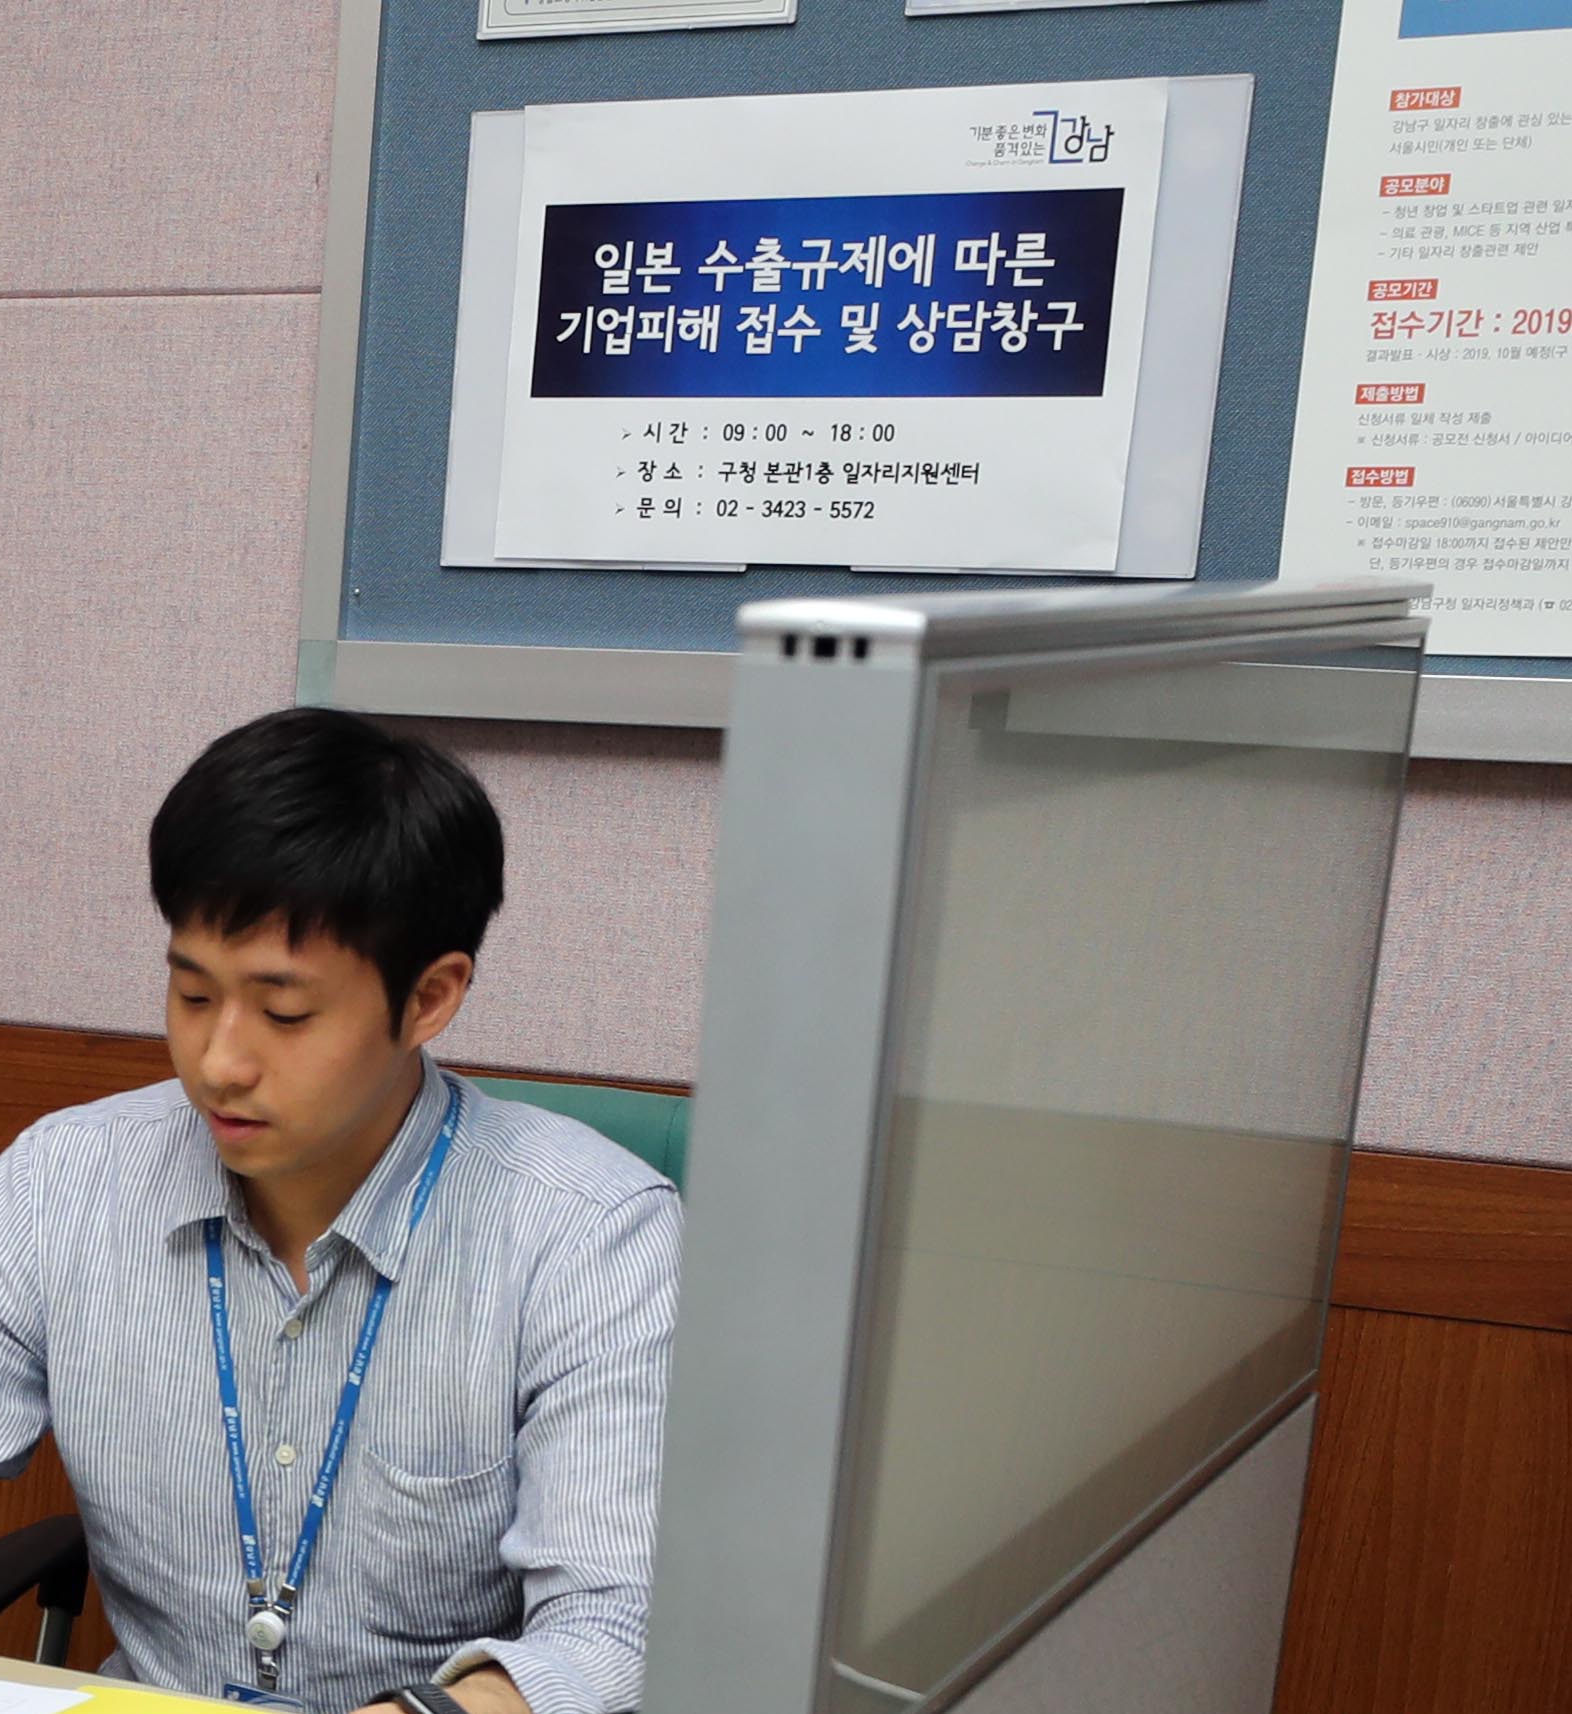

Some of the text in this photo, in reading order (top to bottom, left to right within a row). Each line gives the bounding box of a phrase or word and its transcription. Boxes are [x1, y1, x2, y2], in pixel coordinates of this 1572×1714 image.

[1394, 89, 1456, 109] 참가대상
[969, 123, 1048, 142] 기분 좋은 변화
[1392, 118, 1429, 134] 강남구
[1434, 116, 1470, 132] 일자리
[1475, 114, 1513, 130] 창출에
[1517, 112, 1543, 128] 관심
[1060, 114, 1115, 163] 강남
[1472, 136, 1498, 151] 또는
[1502, 134, 1533, 150] 단체)
[994, 141, 1046, 158] 품격있는
[1383, 176, 1445, 195] 공모분야
[1393, 204, 1418, 220] 청년
[1423, 203, 1448, 218] 창업
[1468, 200, 1519, 217] 스타트업
[1523, 199, 1549, 215] 관련
[1392, 225, 1416, 241] 의료
[1453, 223, 1486, 239] MICE
[1505, 221, 1531, 237] 지역
[1536, 220, 1561, 236] 산업
[1388, 242, 1540, 261] 기타 일자리 창출관련 제안
[593, 230, 1056, 296] 일본 수출규제에 따른
[1371, 281, 1434, 300] 공모기간
[555, 298, 1086, 356] 기업피해 접수 및 상담창구
[1370, 308, 1485, 341] 접수기간
[1365, 347, 1414, 363] 결과발표
[1425, 346, 1451, 361] 시상
[1360, 385, 1420, 403] 제출방법
[1357, 411, 1493, 427] 신청서류 일체 작성 제출
[1371, 433, 1421, 448] 신청서류
[1432, 432, 1469, 447] 공모전
[1473, 432, 1512, 447] 신청서
[716, 460, 758, 486] 구청
[762, 461, 834, 486] 본관1층
[842, 461, 981, 487] 일자리지원센터
[1350, 469, 1409, 486] 접수방법
[1391, 494, 1440, 509] 등기우편
[1492, 493, 1557, 509] 서울특별시
[1357, 516, 1394, 530] 이메일
[1405, 516, 1562, 532] space910@gangnam.go.kr
[1436, 536, 1489, 550] 18:00까지
[1493, 536, 1531, 551] 접수된
[1389, 557, 1449, 571] 등기우편의
[1461, 596, 1535, 612] 일자리정책과
